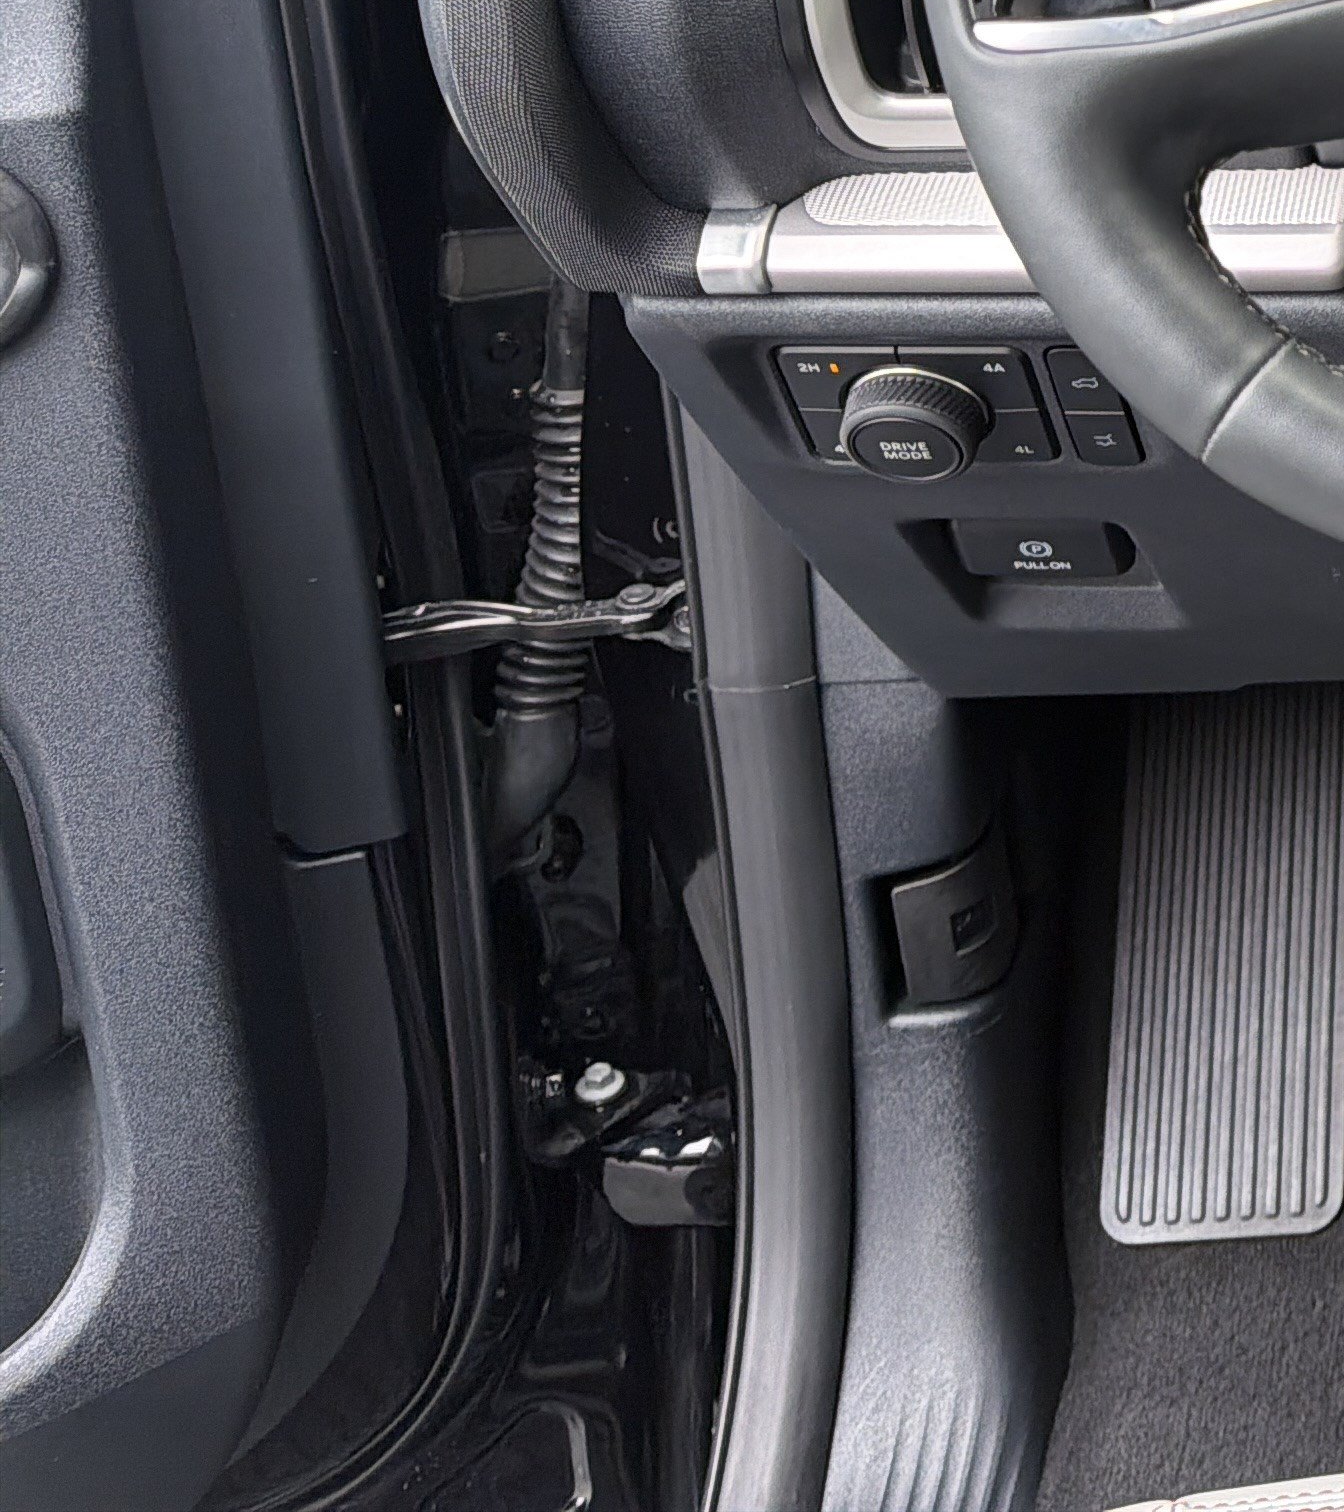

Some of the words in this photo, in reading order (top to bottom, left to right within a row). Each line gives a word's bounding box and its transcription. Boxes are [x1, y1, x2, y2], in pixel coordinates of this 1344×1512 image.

[796, 361, 821, 374] 2H
[982, 361, 1006, 374] 4A
[878, 440, 929, 451] DRIVE
[1014, 444, 1035, 455] 4L
[883, 450, 933, 461] MODE
[1013, 560, 1050, 570] PULL
[1049, 560, 1072, 571] ON
